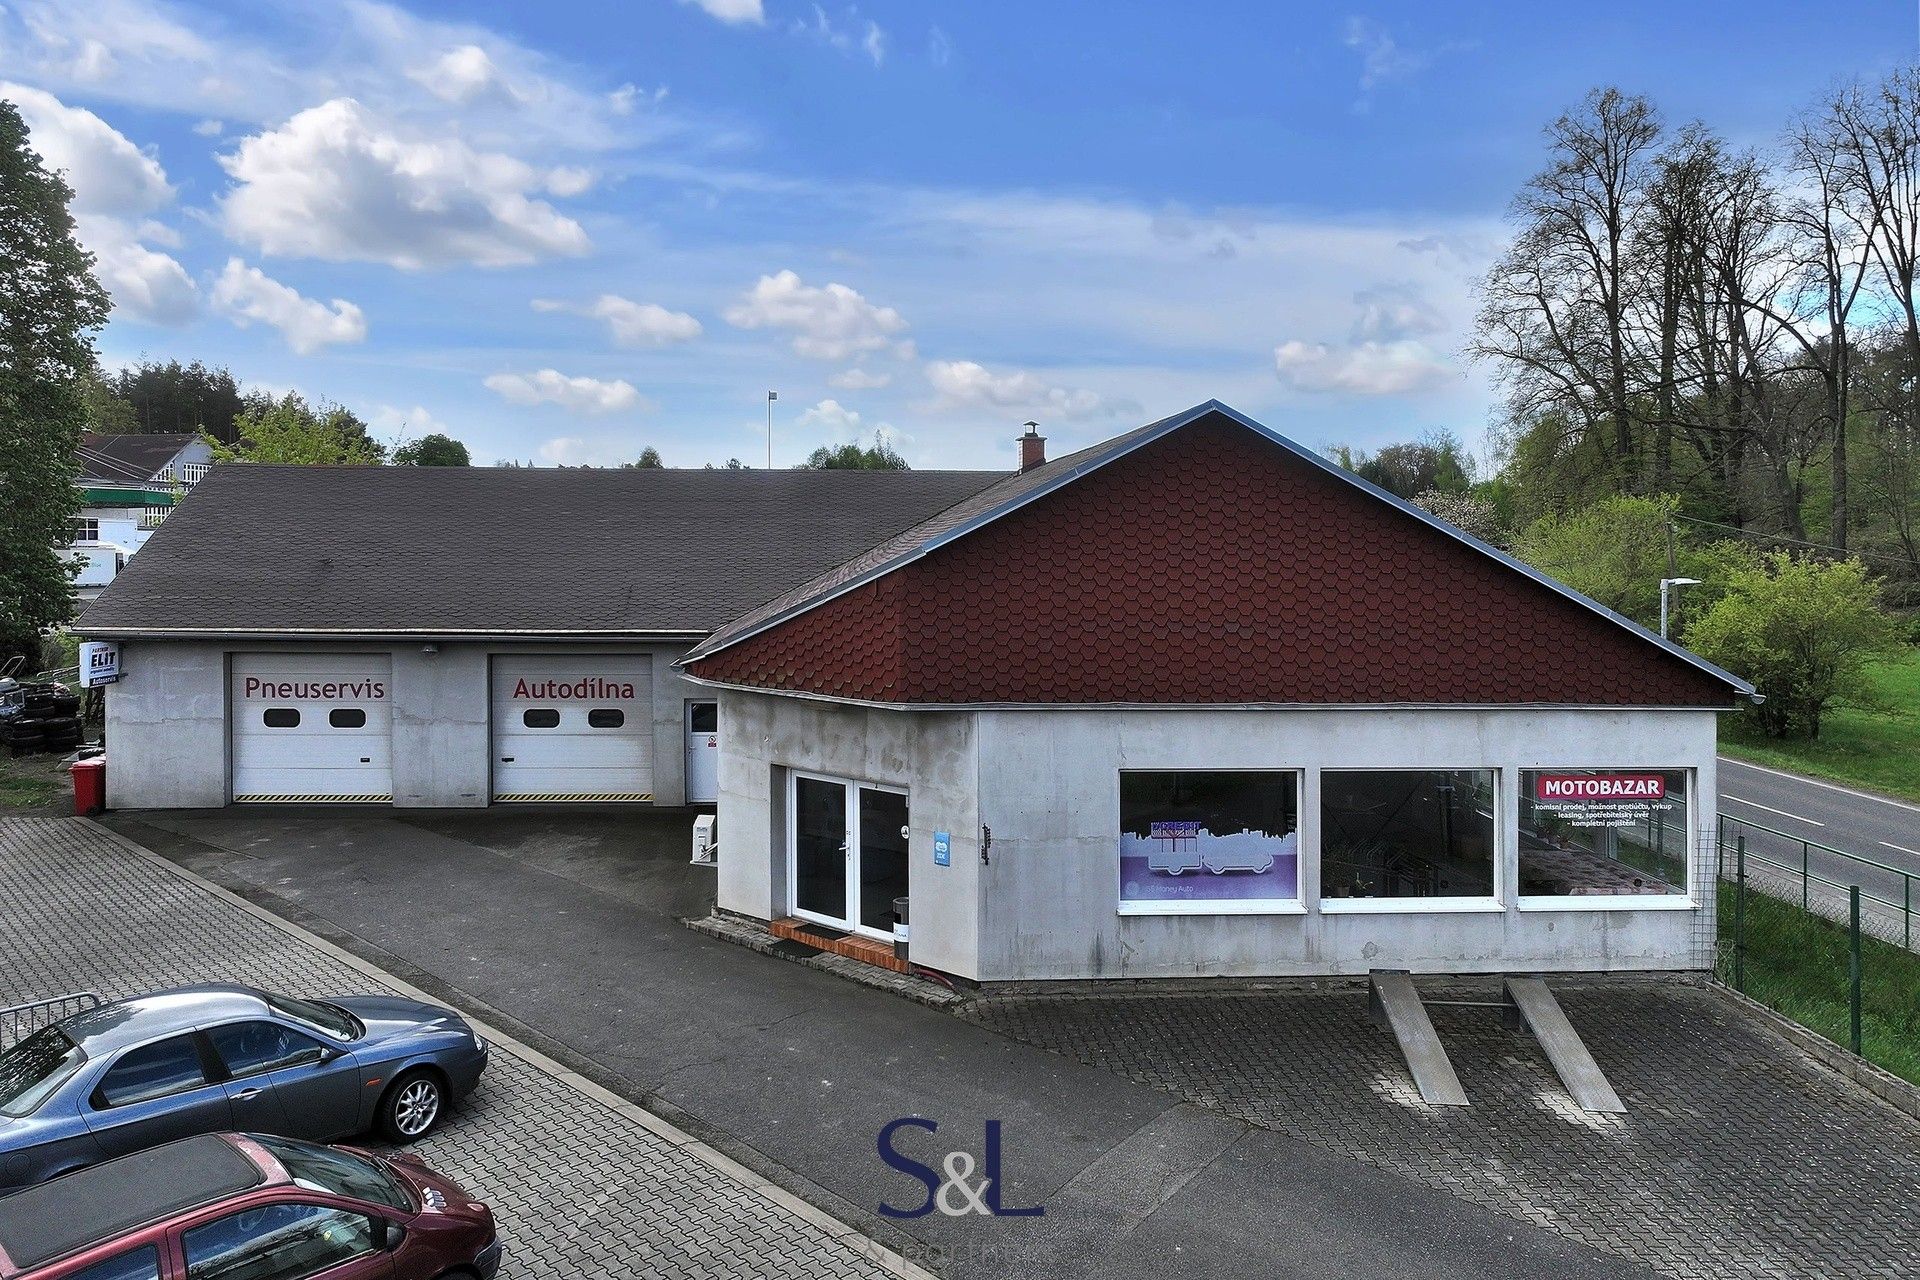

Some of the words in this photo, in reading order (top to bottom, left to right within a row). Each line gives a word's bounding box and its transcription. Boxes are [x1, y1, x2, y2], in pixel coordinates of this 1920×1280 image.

[91, 652, 115, 667] ELIT
[245, 677, 385, 699] Pneuservis
[513, 677, 635, 699] Autodílna
[1545, 780, 1660, 795] MOTOBAZAR
[1562, 803, 1587, 811] prodej,
[1617, 802, 1651, 811] protiúčtu,
[1651, 802, 1673, 811] výkup
[1558, 812, 1585, 820] leasing,
[1585, 811, 1633, 819] spotřebitelský
[1571, 820, 1606, 828] kompletní
[1606, 819, 1636, 828] pojištění
[1178, 885, 1194, 893] Auto
